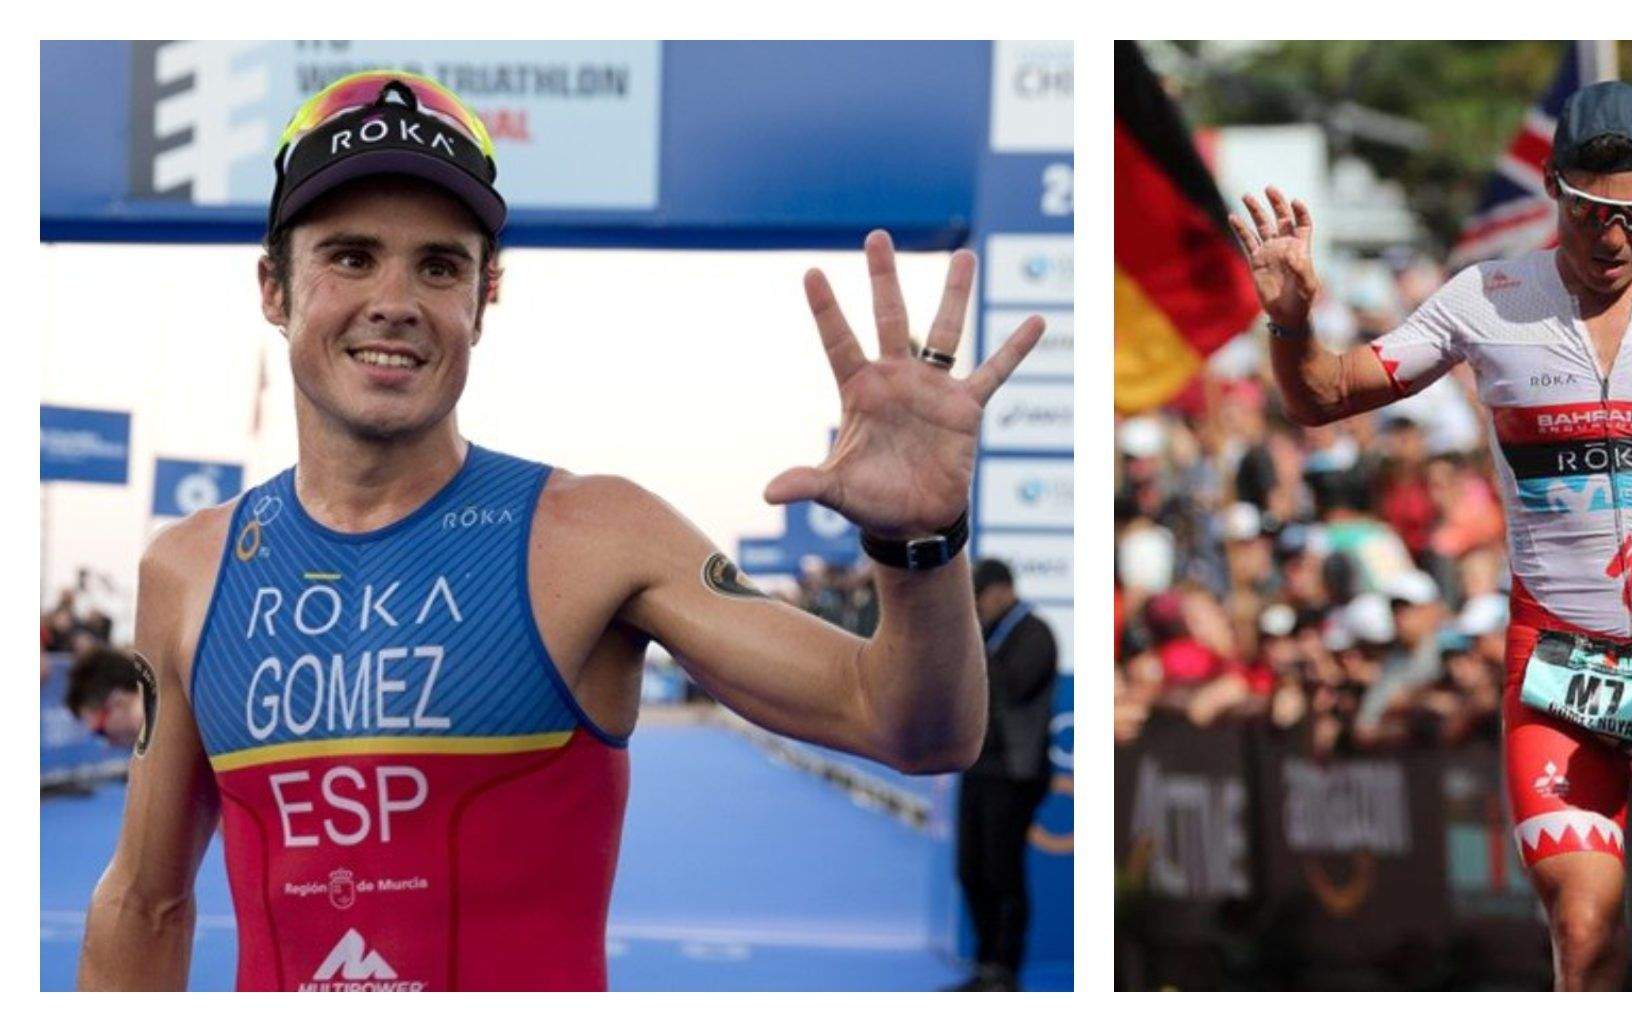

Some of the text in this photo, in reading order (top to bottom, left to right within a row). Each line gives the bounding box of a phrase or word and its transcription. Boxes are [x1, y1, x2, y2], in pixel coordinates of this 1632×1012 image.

[245, 645, 452, 741] GOMEZ
[1565, 673, 1625, 716] M7
[268, 765, 429, 848] ESP
[356, 879, 374, 893] de
[377, 876, 428, 891] Murcia
